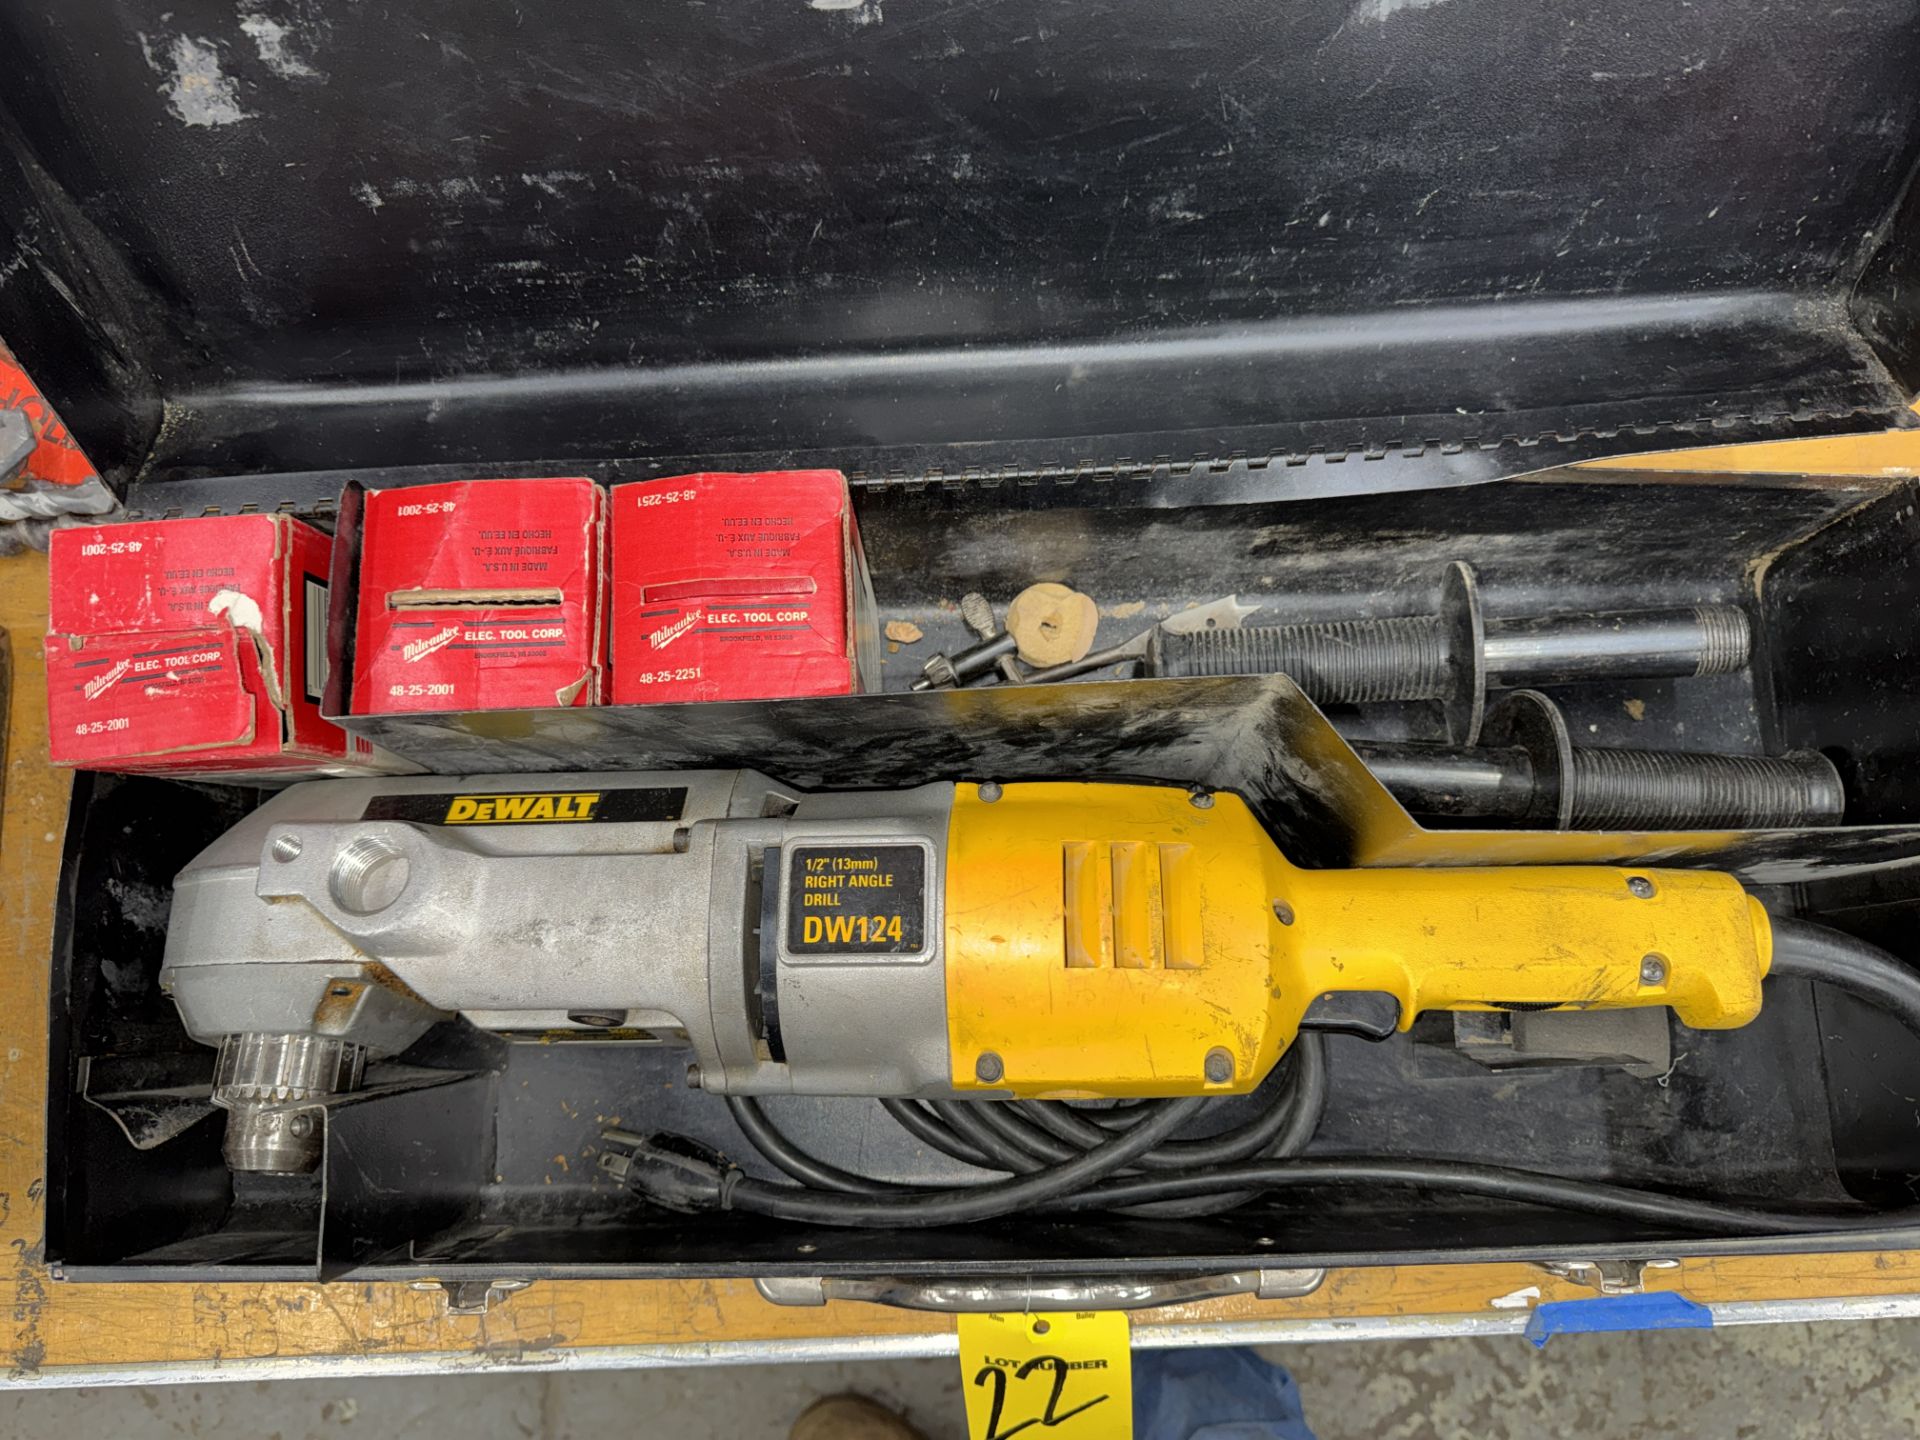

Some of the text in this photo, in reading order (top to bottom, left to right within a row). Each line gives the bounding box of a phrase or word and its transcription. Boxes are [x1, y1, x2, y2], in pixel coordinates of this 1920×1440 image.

[637, 489, 697, 508] 48-25-2251
[397, 501, 457, 517] 48-25-2001
[508, 530, 520, 539] EN
[522, 530, 552, 539] HECHO
[737, 533, 756, 542] AUX
[81, 541, 143, 556] 48-25-2001
[495, 546, 513, 556] AUX
[754, 549, 763, 557] IN
[765, 549, 791, 557] MADE
[510, 562, 519, 572] IN
[522, 562, 548, 572] MADE
[650, 609, 811, 649] Milwaukee ELEC. TOOL CORP.
[403, 626, 566, 662] Milwaukee ELEC. TOOL CORP.
[83, 658, 131, 699] Milwaukee
[134, 660, 162, 672] ELEC.
[164, 656, 192, 667] TOOL
[192, 651, 223, 663] CORP.
[639, 667, 701, 684] 48-25-2251
[389, 684, 455, 696] 48-25-2001
[75, 717, 130, 735] 48-25-2001
[805, 856, 878, 872] 1/2" (13mm)
[805, 874, 894, 888] RIGHT ANGLE
[804, 893, 841, 906] DRILL
[803, 915, 903, 943] DW124
[984, 1355, 1021, 1369] LOT
[974, 1355, 1110, 1440] 22
